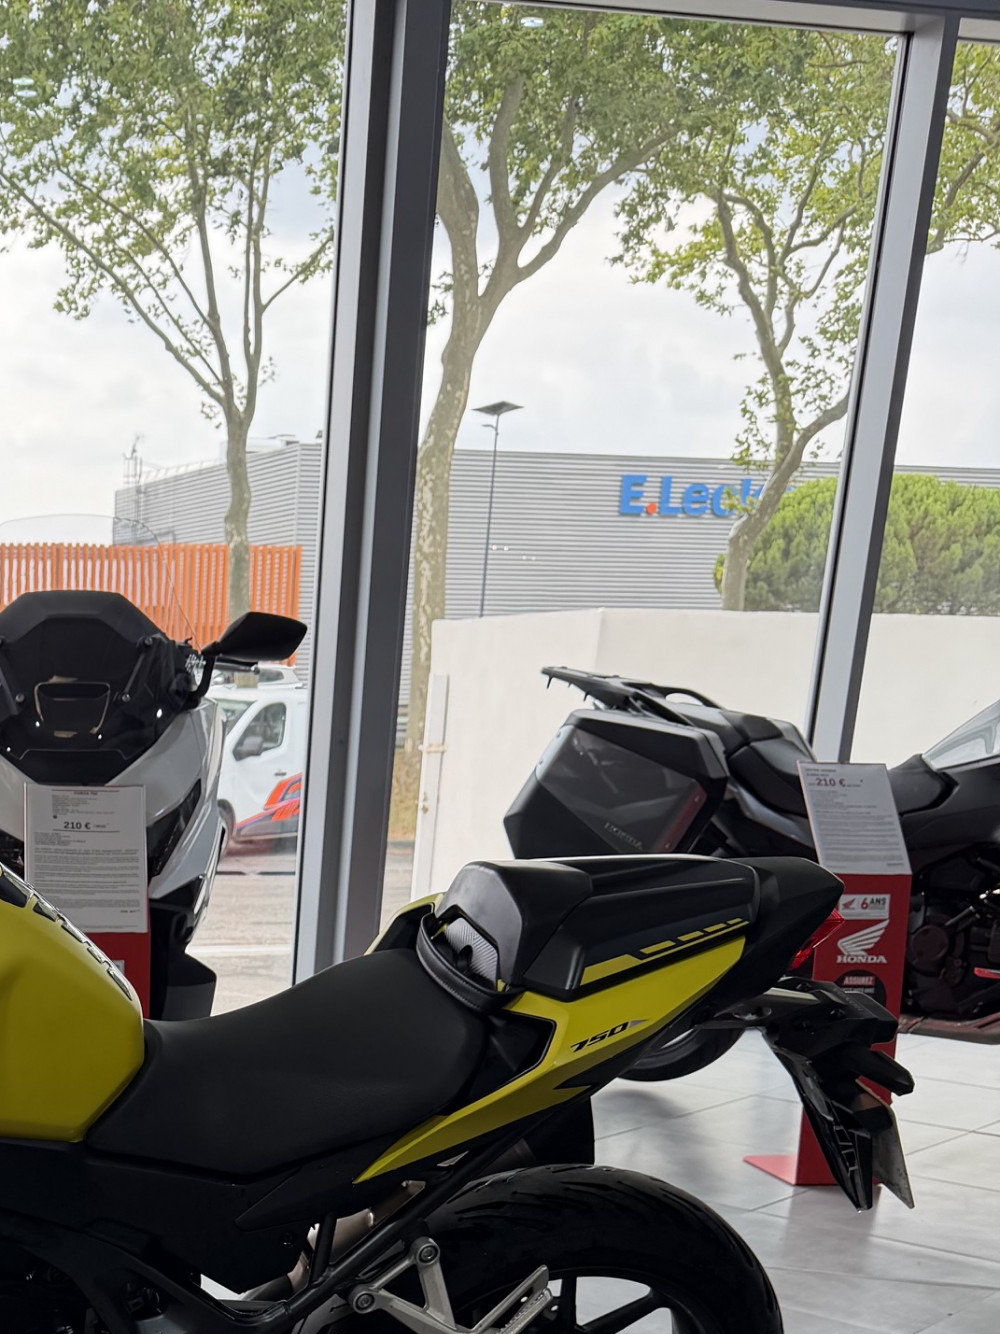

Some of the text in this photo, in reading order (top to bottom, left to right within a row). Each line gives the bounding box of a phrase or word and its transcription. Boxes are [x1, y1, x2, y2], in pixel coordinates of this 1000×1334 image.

[815, 778, 836, 787] 210
[839, 778, 846, 787] €
[63, 821, 82, 830] 210
[85, 822, 91, 830] €
[861, 897, 886, 910] 6 ANS
[836, 955, 888, 964] HONDA
[570, 1021, 630, 1053] 750
